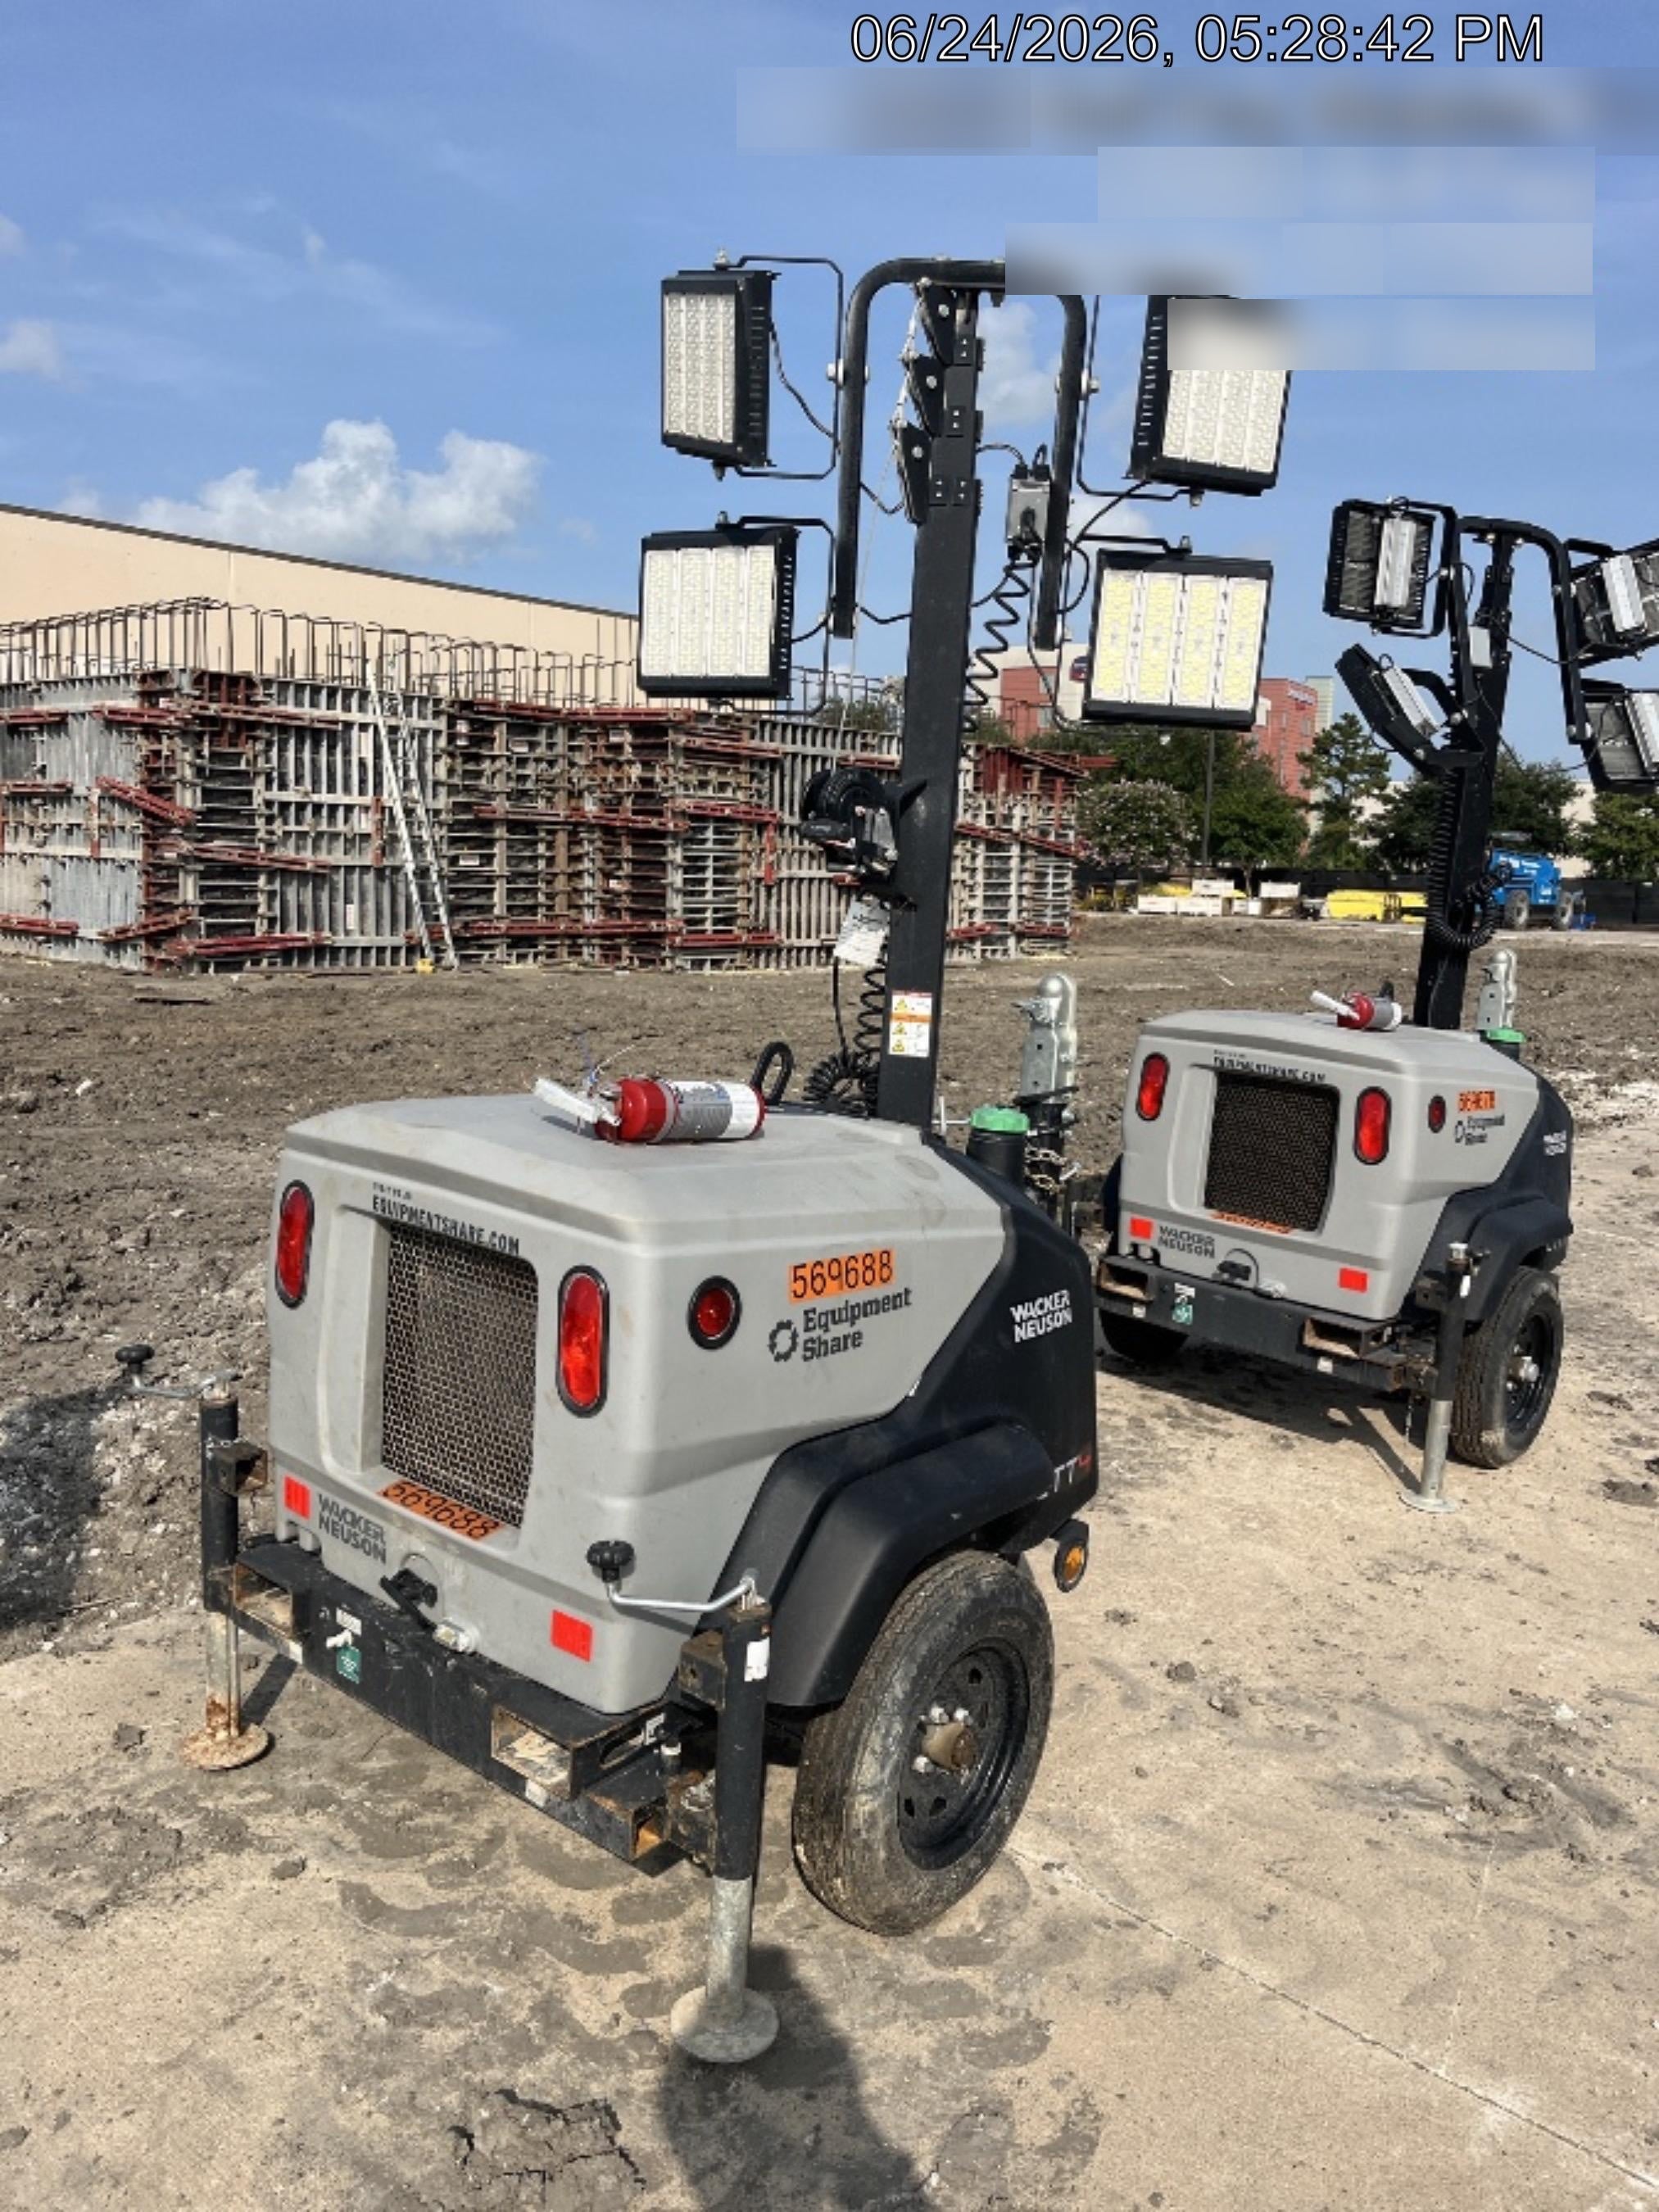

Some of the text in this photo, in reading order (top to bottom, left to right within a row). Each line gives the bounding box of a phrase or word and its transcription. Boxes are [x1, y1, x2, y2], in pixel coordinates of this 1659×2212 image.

[791, 1249, 894, 1299] 569688
[802, 1286, 913, 1334] Equipment
[1010, 1290, 1071, 1321] WACKER
[1013, 1308, 1073, 1343] NEUSON
[802, 1330, 863, 1362] Share
[317, 1494, 387, 1542] WACKER
[382, 1480, 501, 1540] 569688
[318, 1514, 388, 1564] NEUSON
